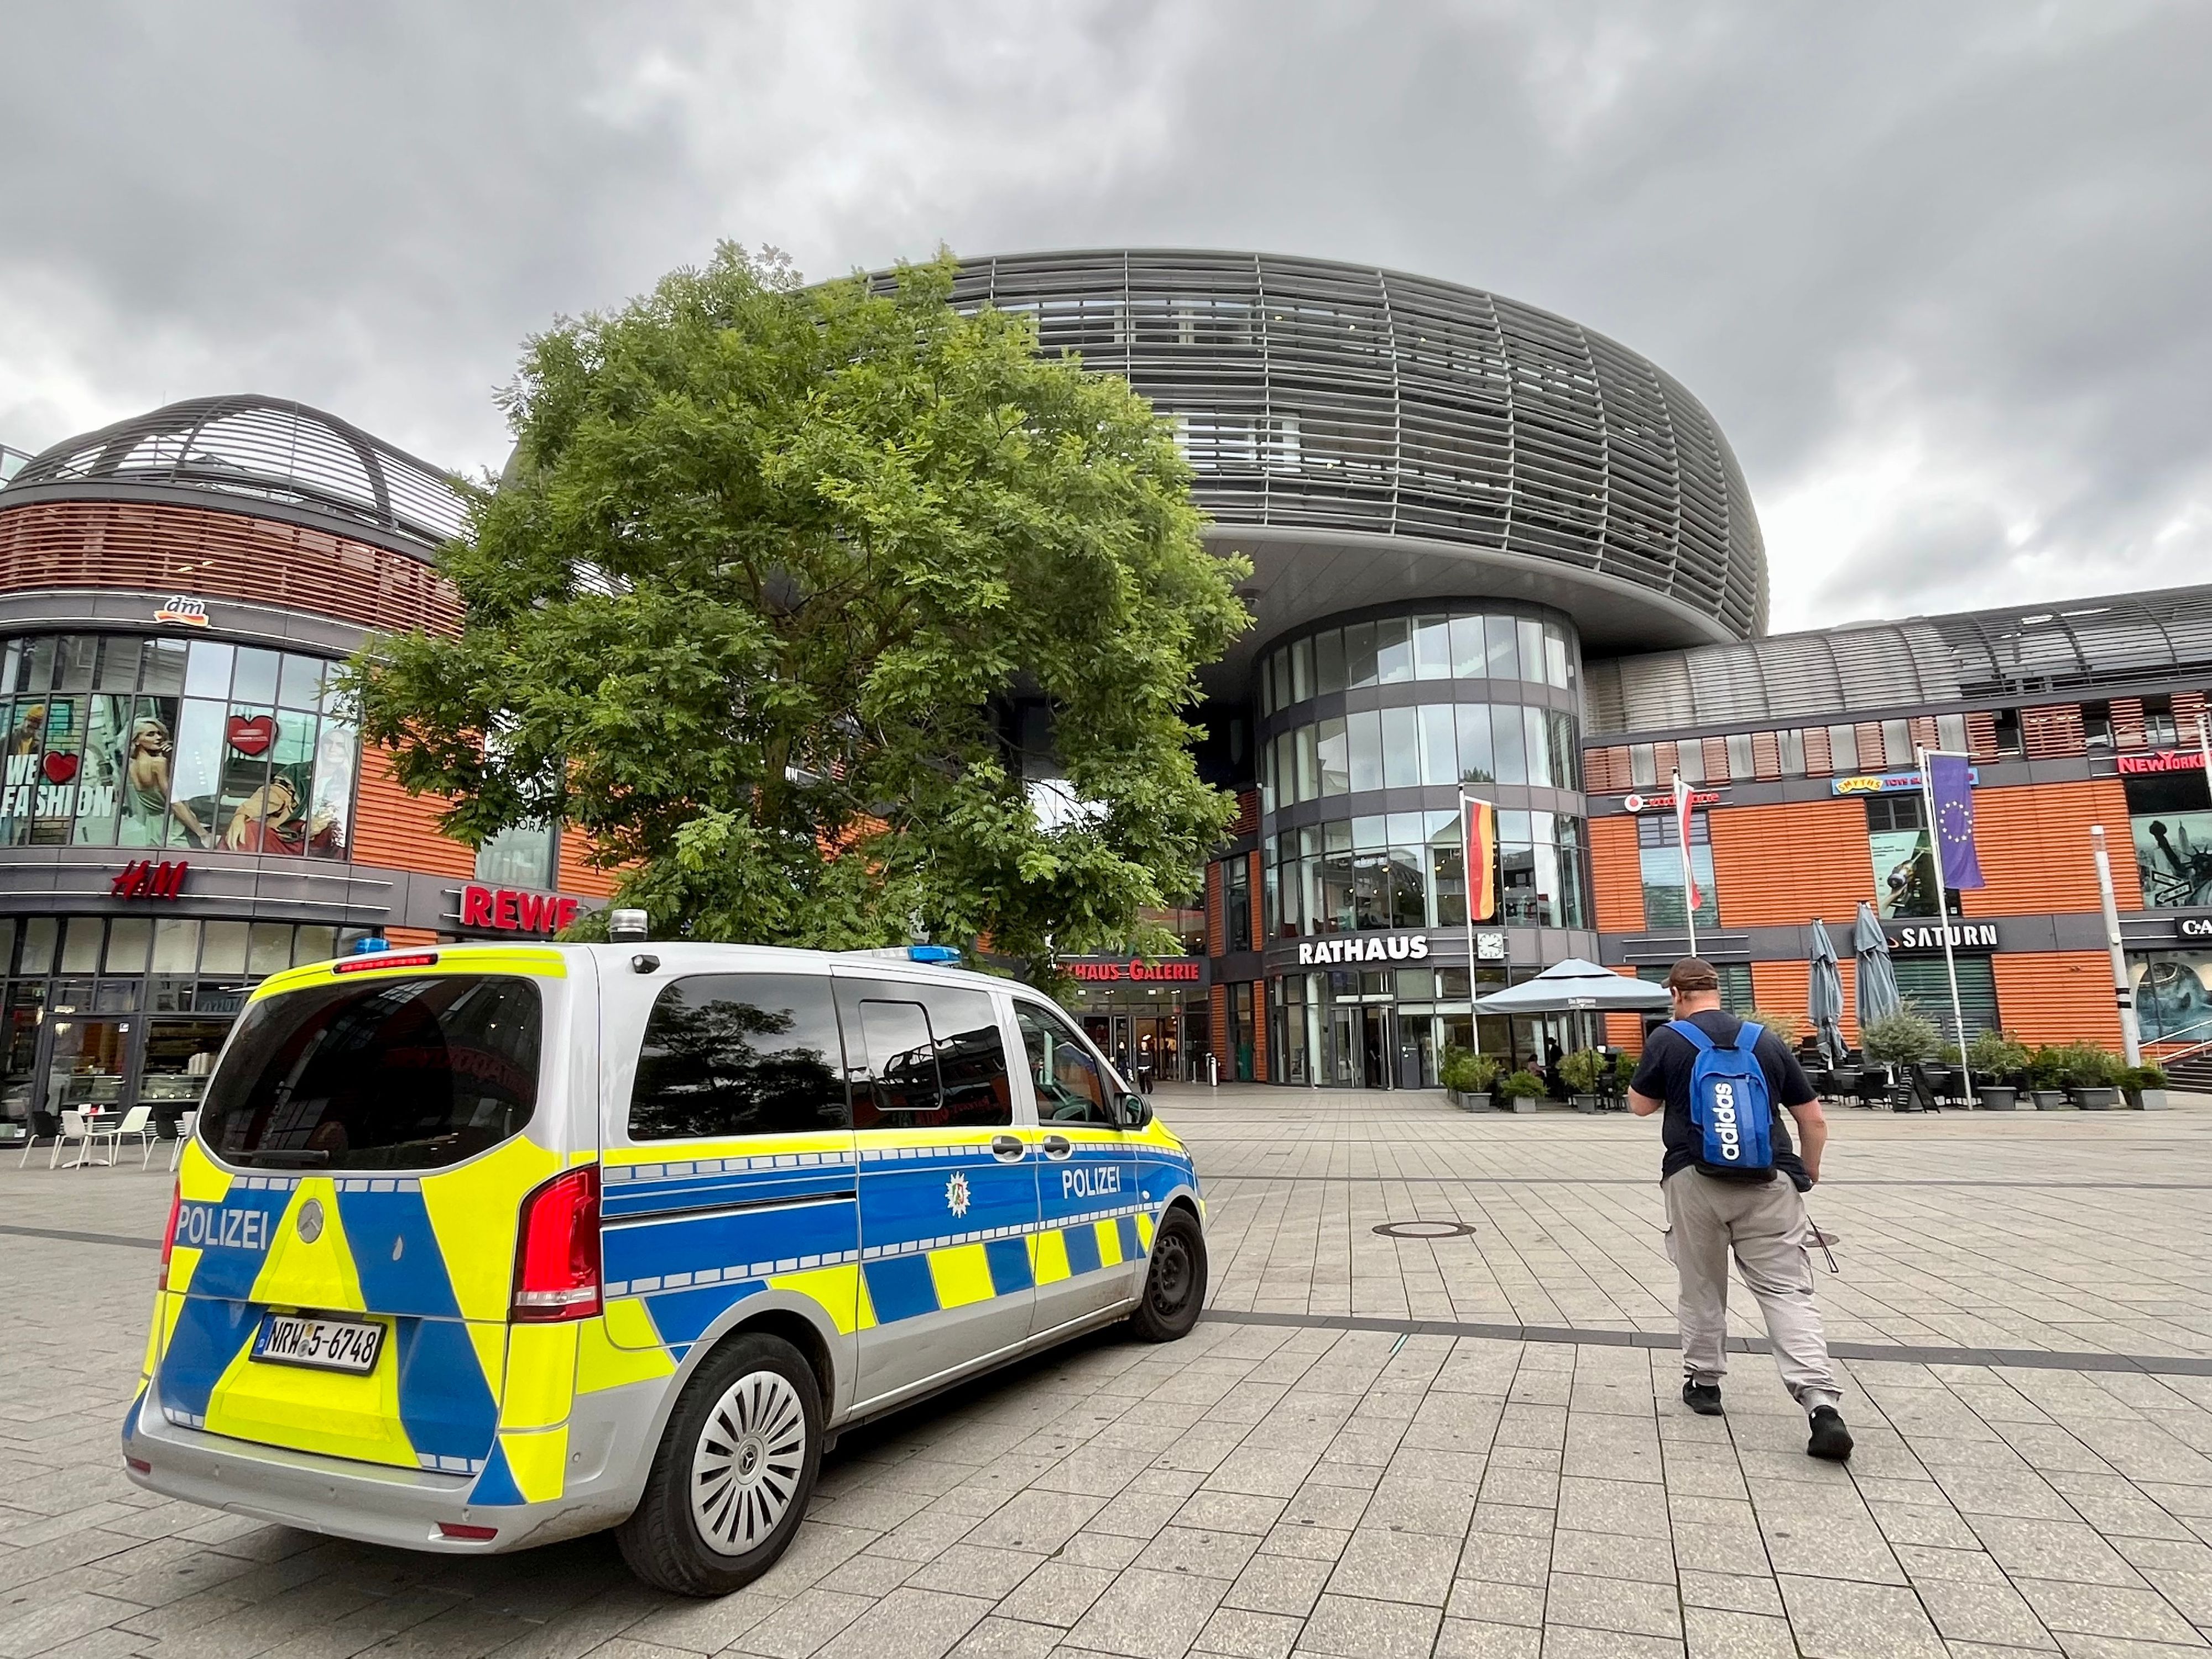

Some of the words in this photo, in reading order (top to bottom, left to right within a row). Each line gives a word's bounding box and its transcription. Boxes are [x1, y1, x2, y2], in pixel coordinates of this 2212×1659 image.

[166, 597, 202, 614] dm
[7, 754, 39, 785] WE
[1837, 779, 1881, 791] SMYTHS
[1, 785, 114, 817] FASHION
[1649, 793, 1720, 806] vodone
[461, 885, 578, 933] REWE
[1299, 936, 1428, 965] RATHAUS
[1902, 925, 1997, 948] SATURN
[1712, 1082, 1740, 1161] adidas
[1062, 1166, 1121, 1199] POLIZEI
[175, 1205, 269, 1250] POLIZEI
[265, 1321, 306, 1355] NRW
[309, 1325, 377, 1363] 5-6748
